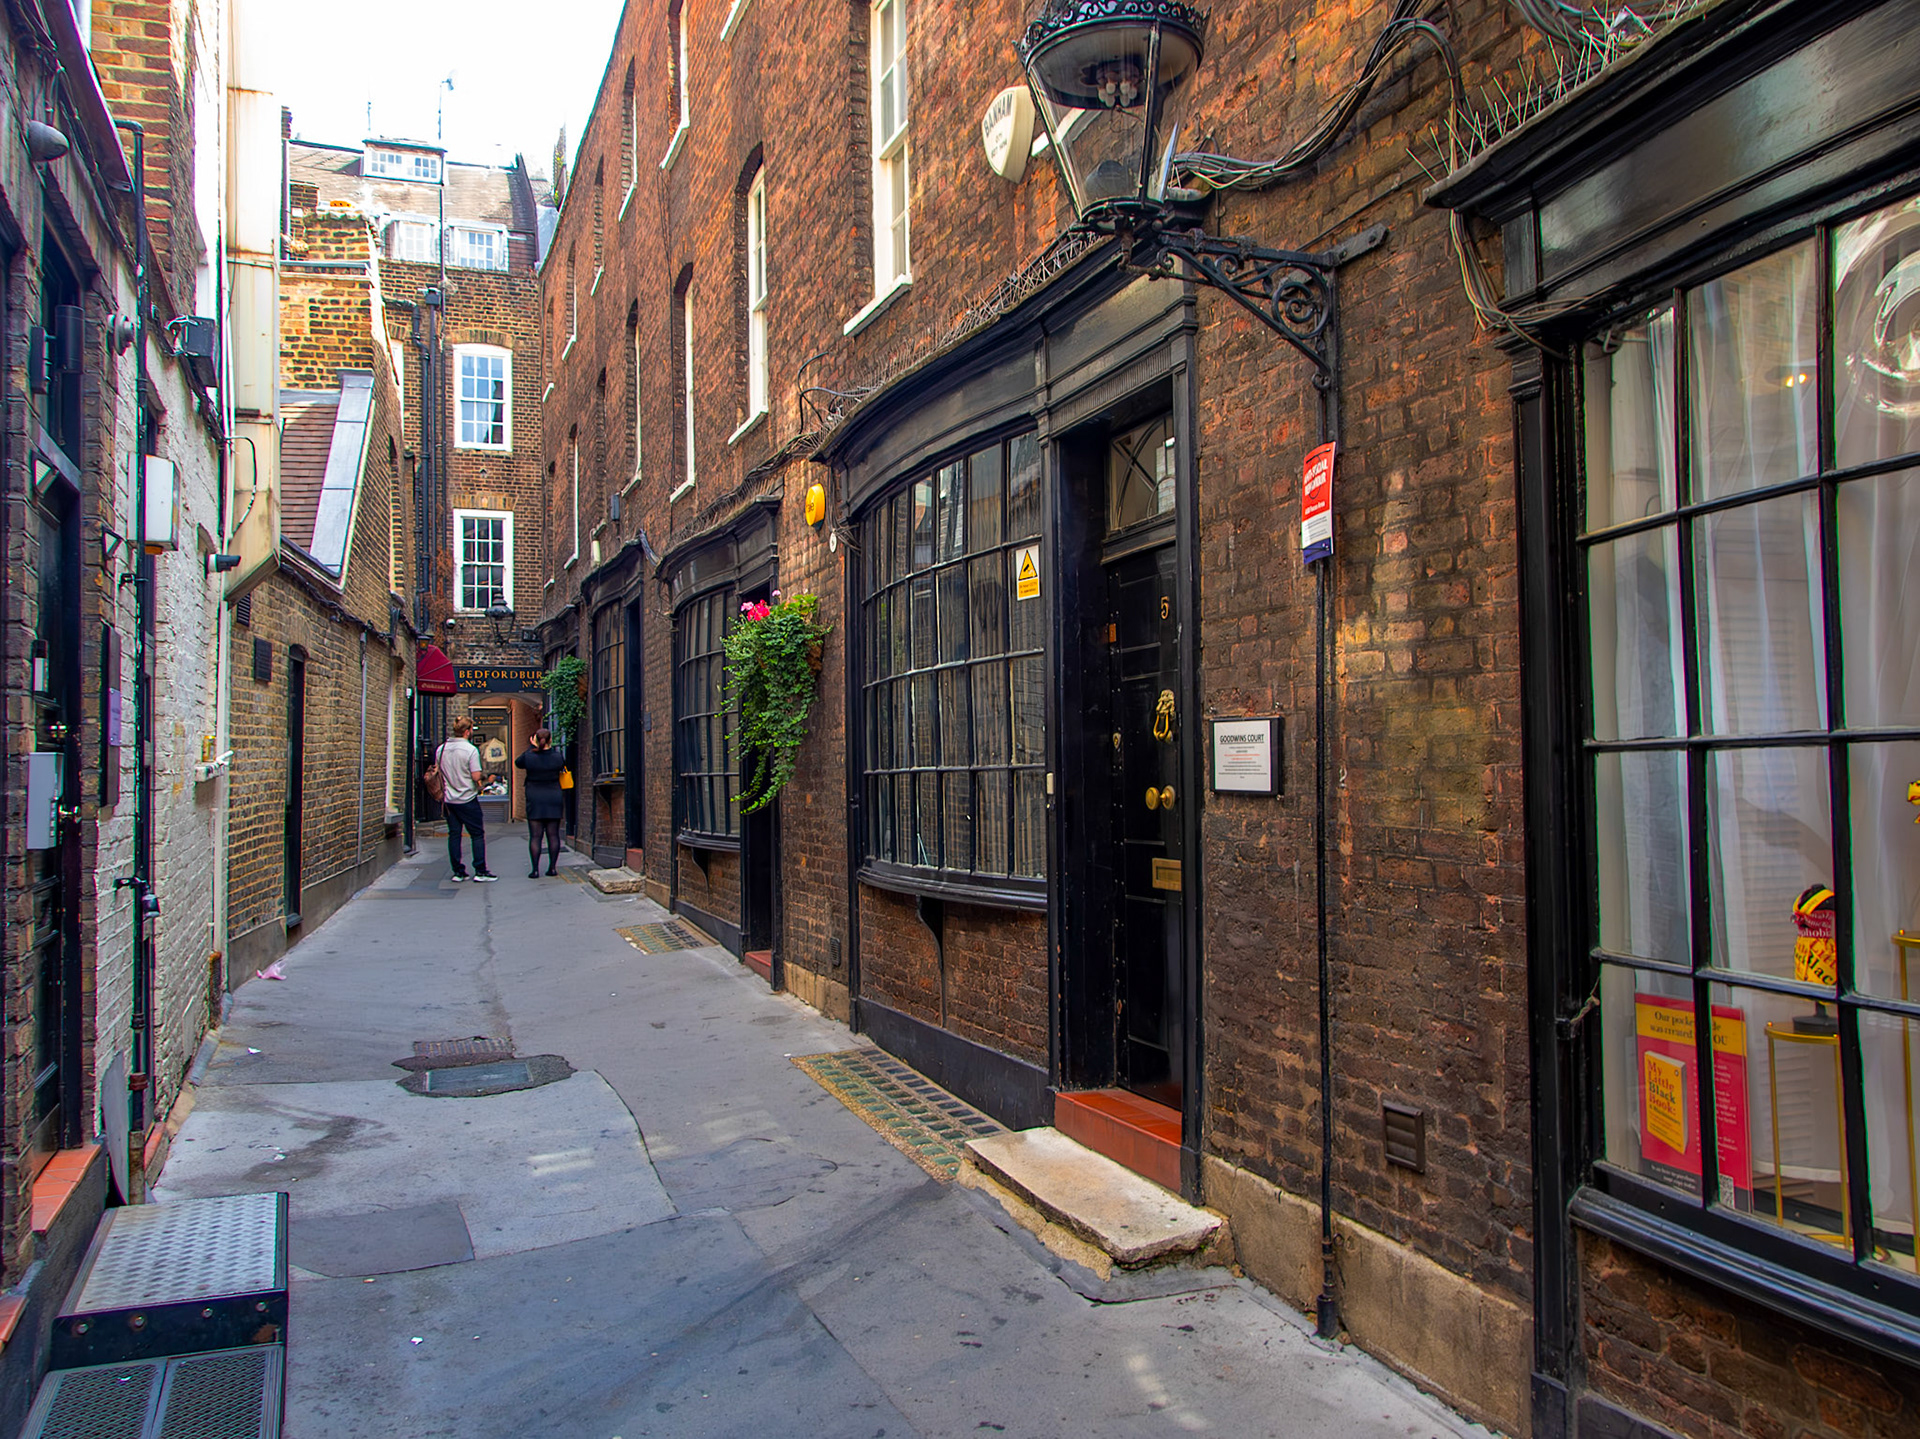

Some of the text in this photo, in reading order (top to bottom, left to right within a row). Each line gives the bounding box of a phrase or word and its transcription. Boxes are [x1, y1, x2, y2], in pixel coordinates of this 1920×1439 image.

[983, 92, 1013, 138] BANHAM
[1160, 596, 1169, 620] 5
[459, 670, 543, 679] BEDFORDBUR
[477, 680, 487, 688] 24
[1220, 733, 1264, 743] GOODWINS COURT
[1654, 1010, 1695, 1026] Our pocke
[1713, 1034, 1728, 1045] OU
[1648, 1059, 1662, 1076] My
[1649, 1070, 1675, 1091] Little
[1649, 1081, 1676, 1104] Black
